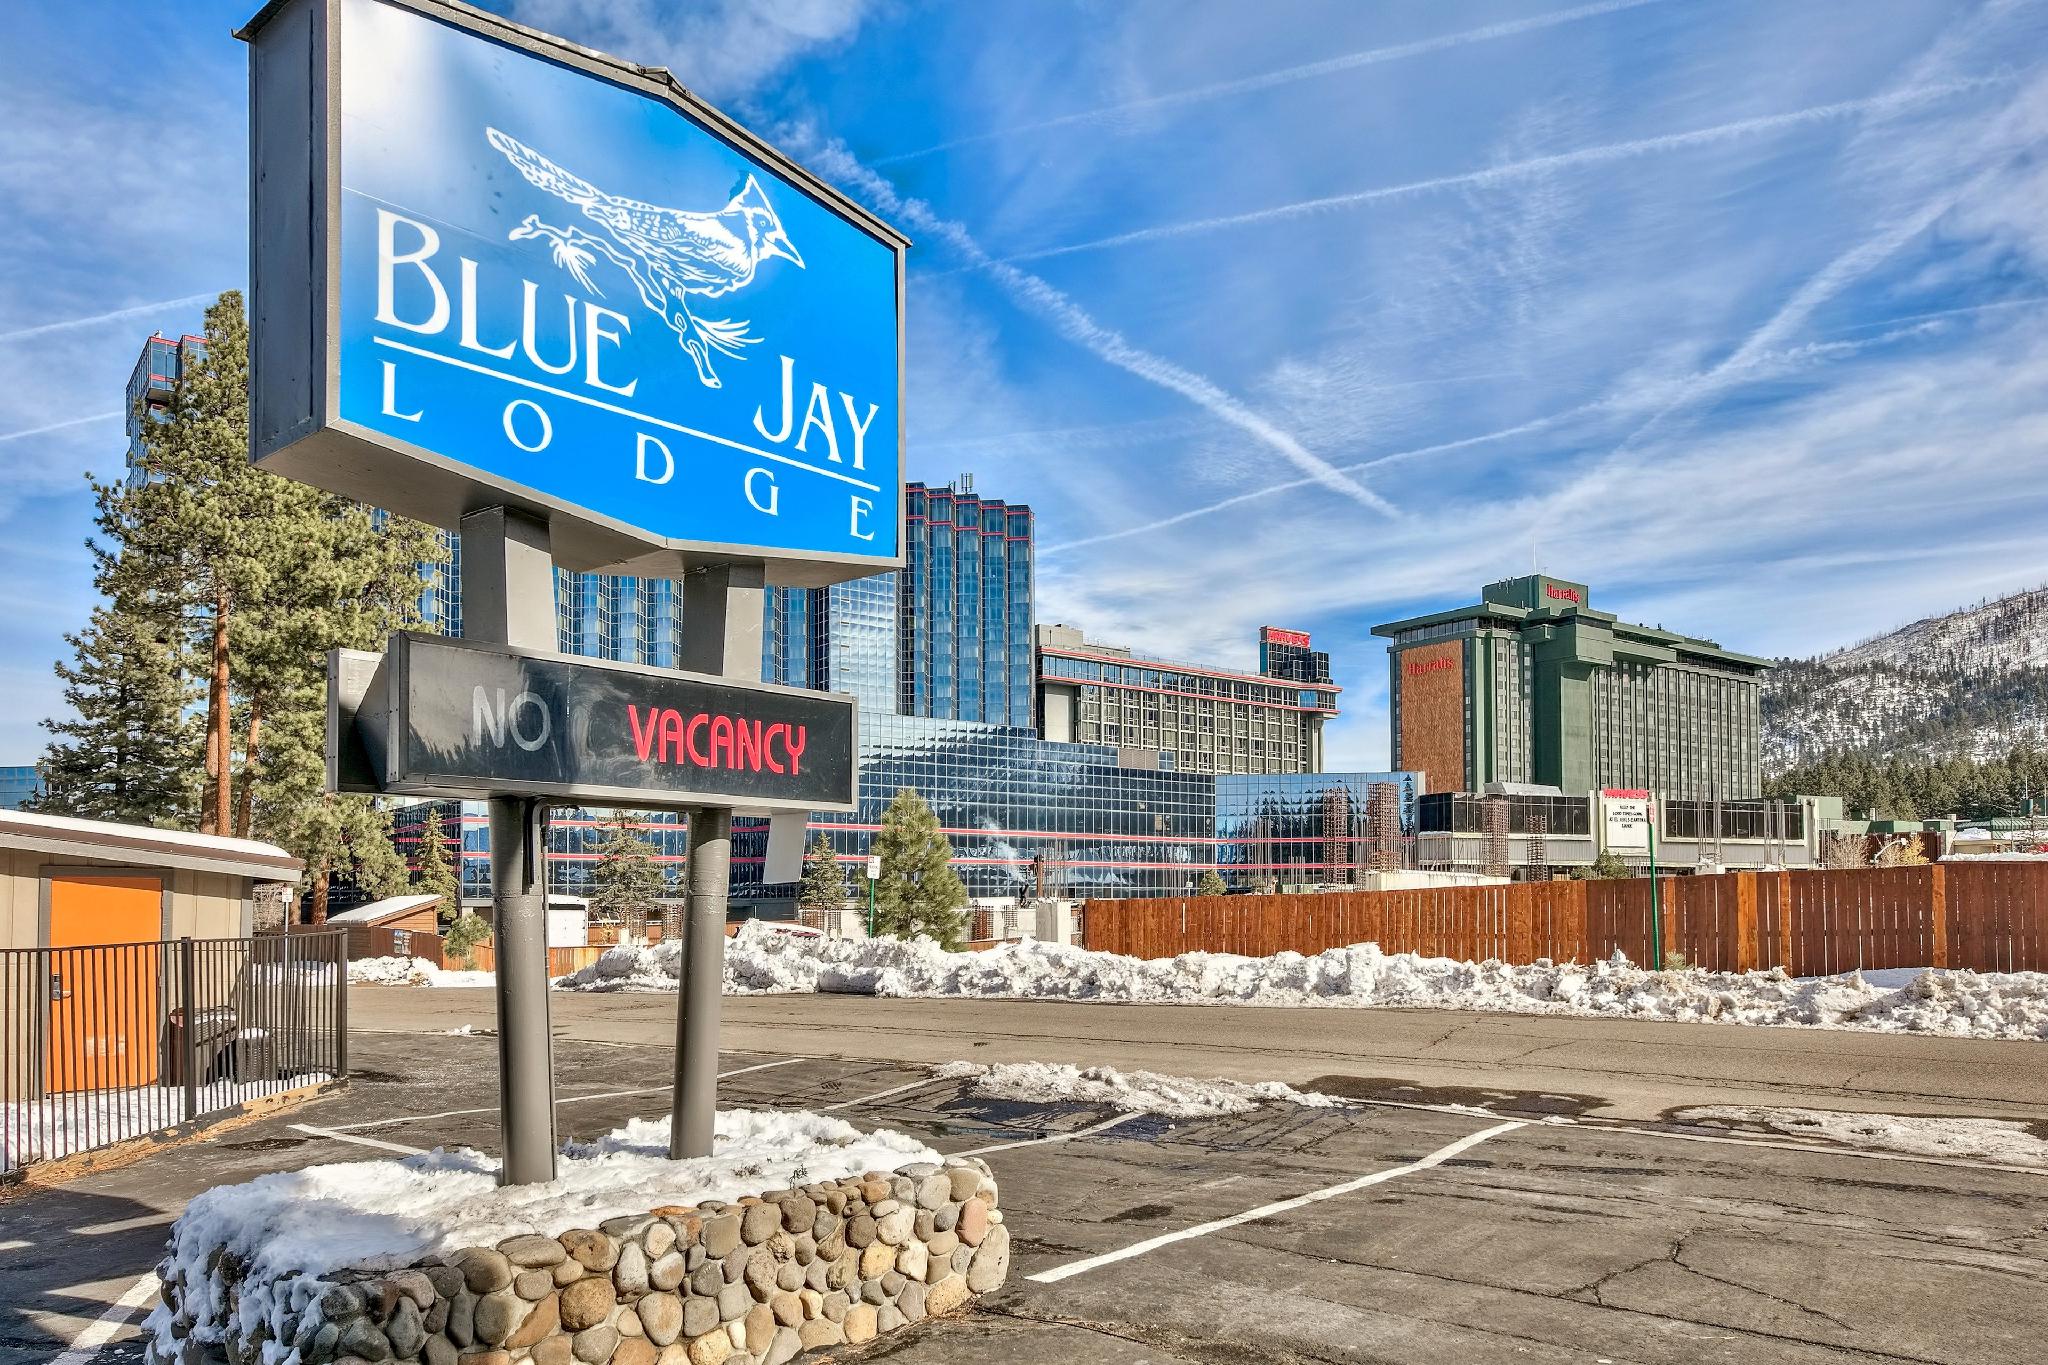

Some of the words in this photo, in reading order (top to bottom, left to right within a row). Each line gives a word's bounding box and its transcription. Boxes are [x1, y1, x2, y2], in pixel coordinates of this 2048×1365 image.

[374, 208, 638, 397] BLUE
[753, 355, 880, 472] JAY
[381, 361, 876, 541] LODGE
[473, 685, 552, 752] NO
[627, 704, 806, 776] VACANCY
